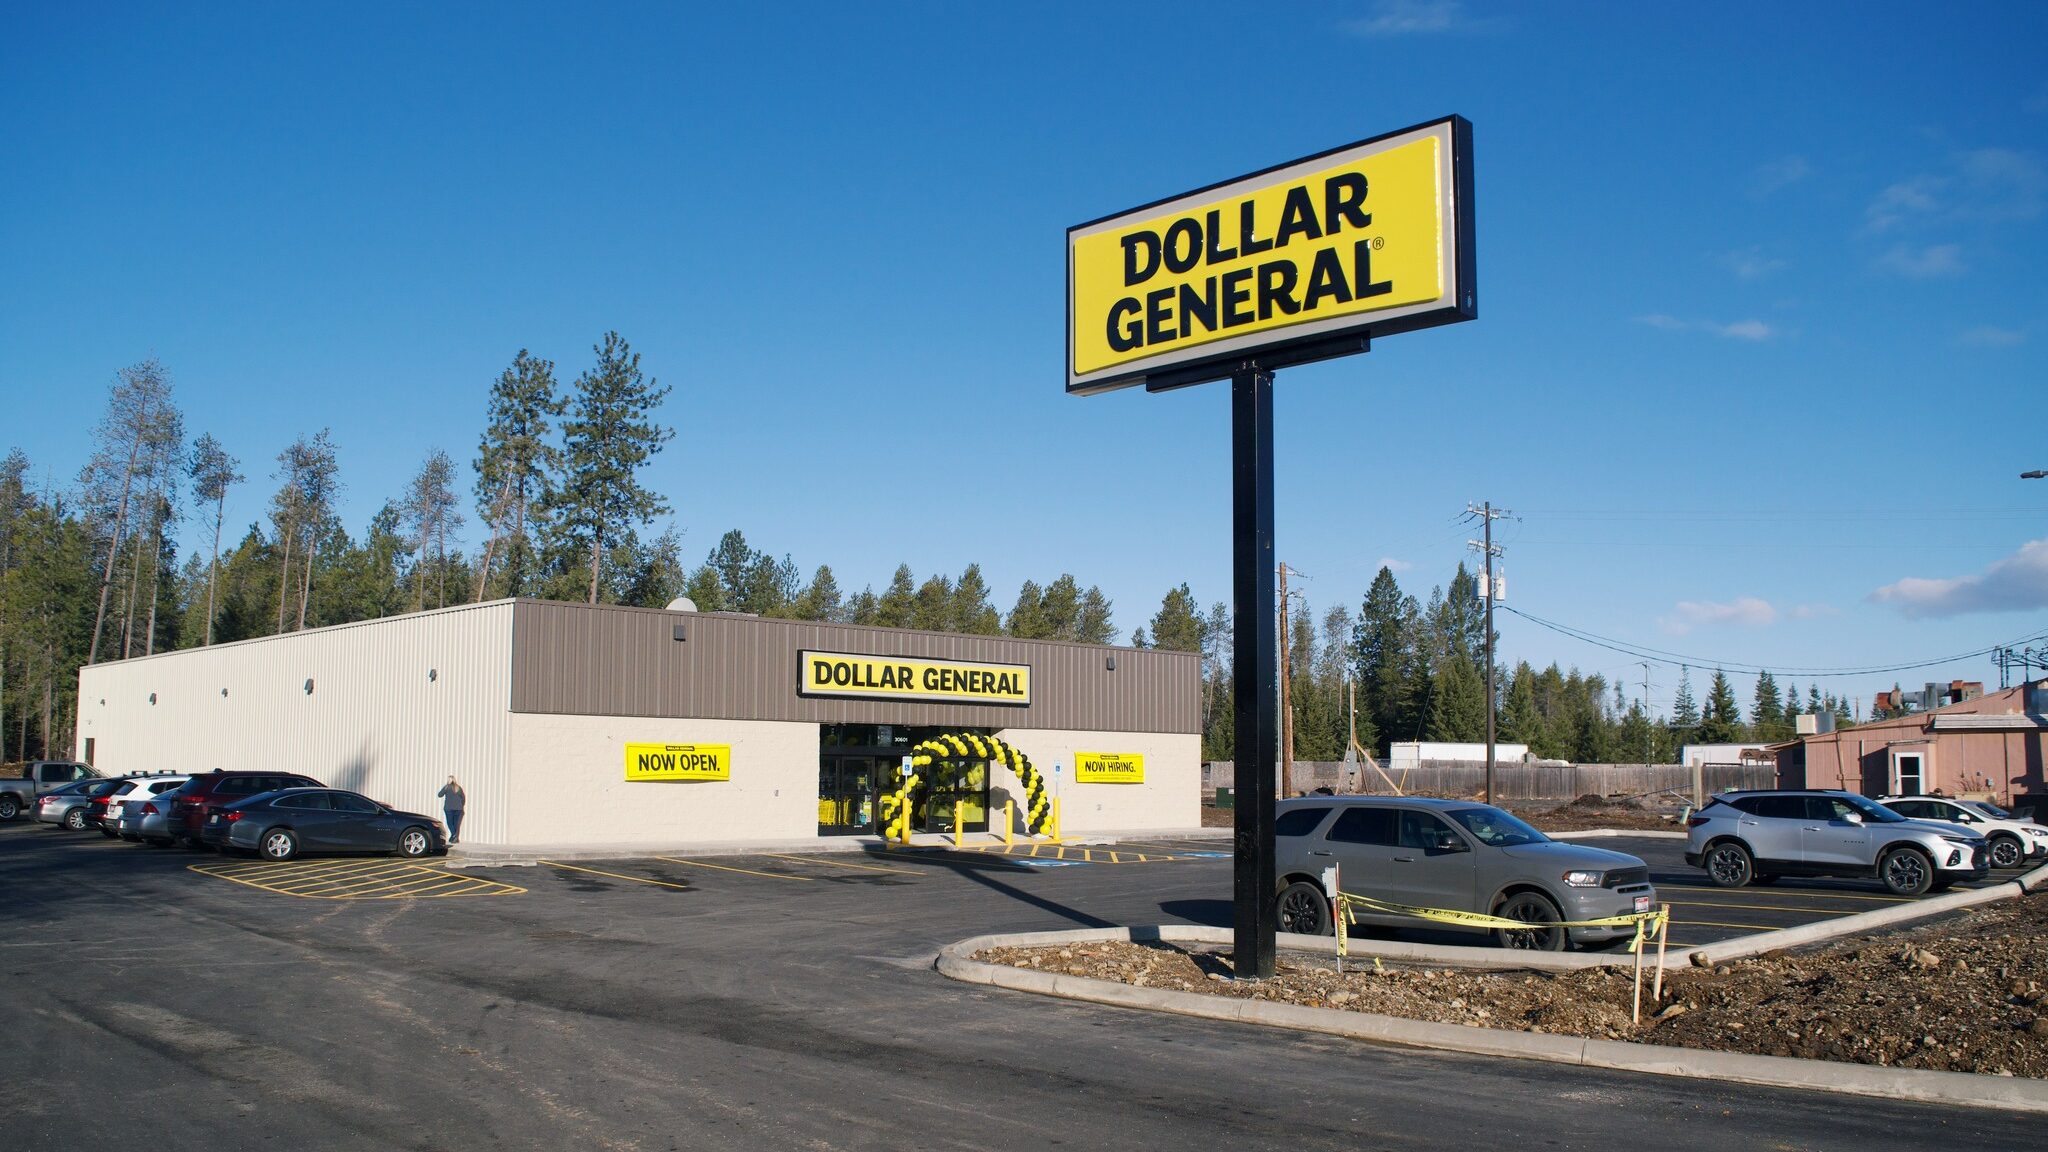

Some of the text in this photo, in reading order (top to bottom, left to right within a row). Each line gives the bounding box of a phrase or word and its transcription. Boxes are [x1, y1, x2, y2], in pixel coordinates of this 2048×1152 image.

[1120, 172, 1372, 287] DOLLAR
[813, 660, 1024, 695] DOLLAR GENERAL
[638, 754, 720, 771] NOW OPEN.
[1085, 761, 1106, 772] NOW
